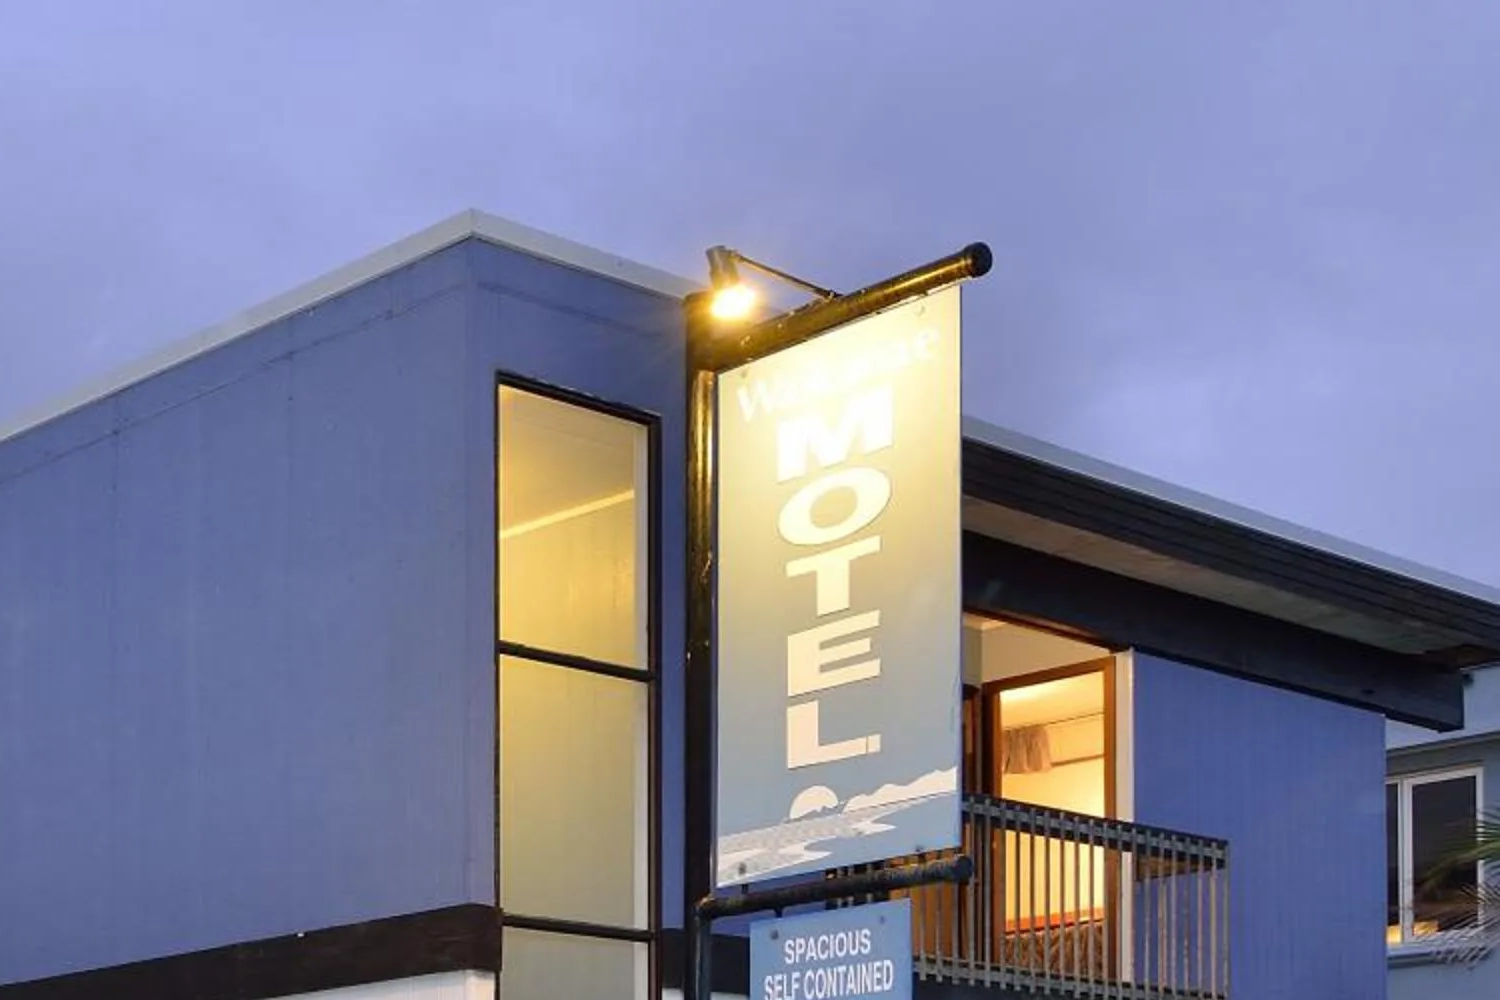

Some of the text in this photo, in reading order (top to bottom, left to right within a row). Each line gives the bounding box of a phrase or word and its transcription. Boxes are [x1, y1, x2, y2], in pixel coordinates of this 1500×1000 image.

[776, 382, 893, 770] MOTEL
[784, 928, 871, 964] SPACIOUS
[804, 959, 893, 1000] CONTAINED
